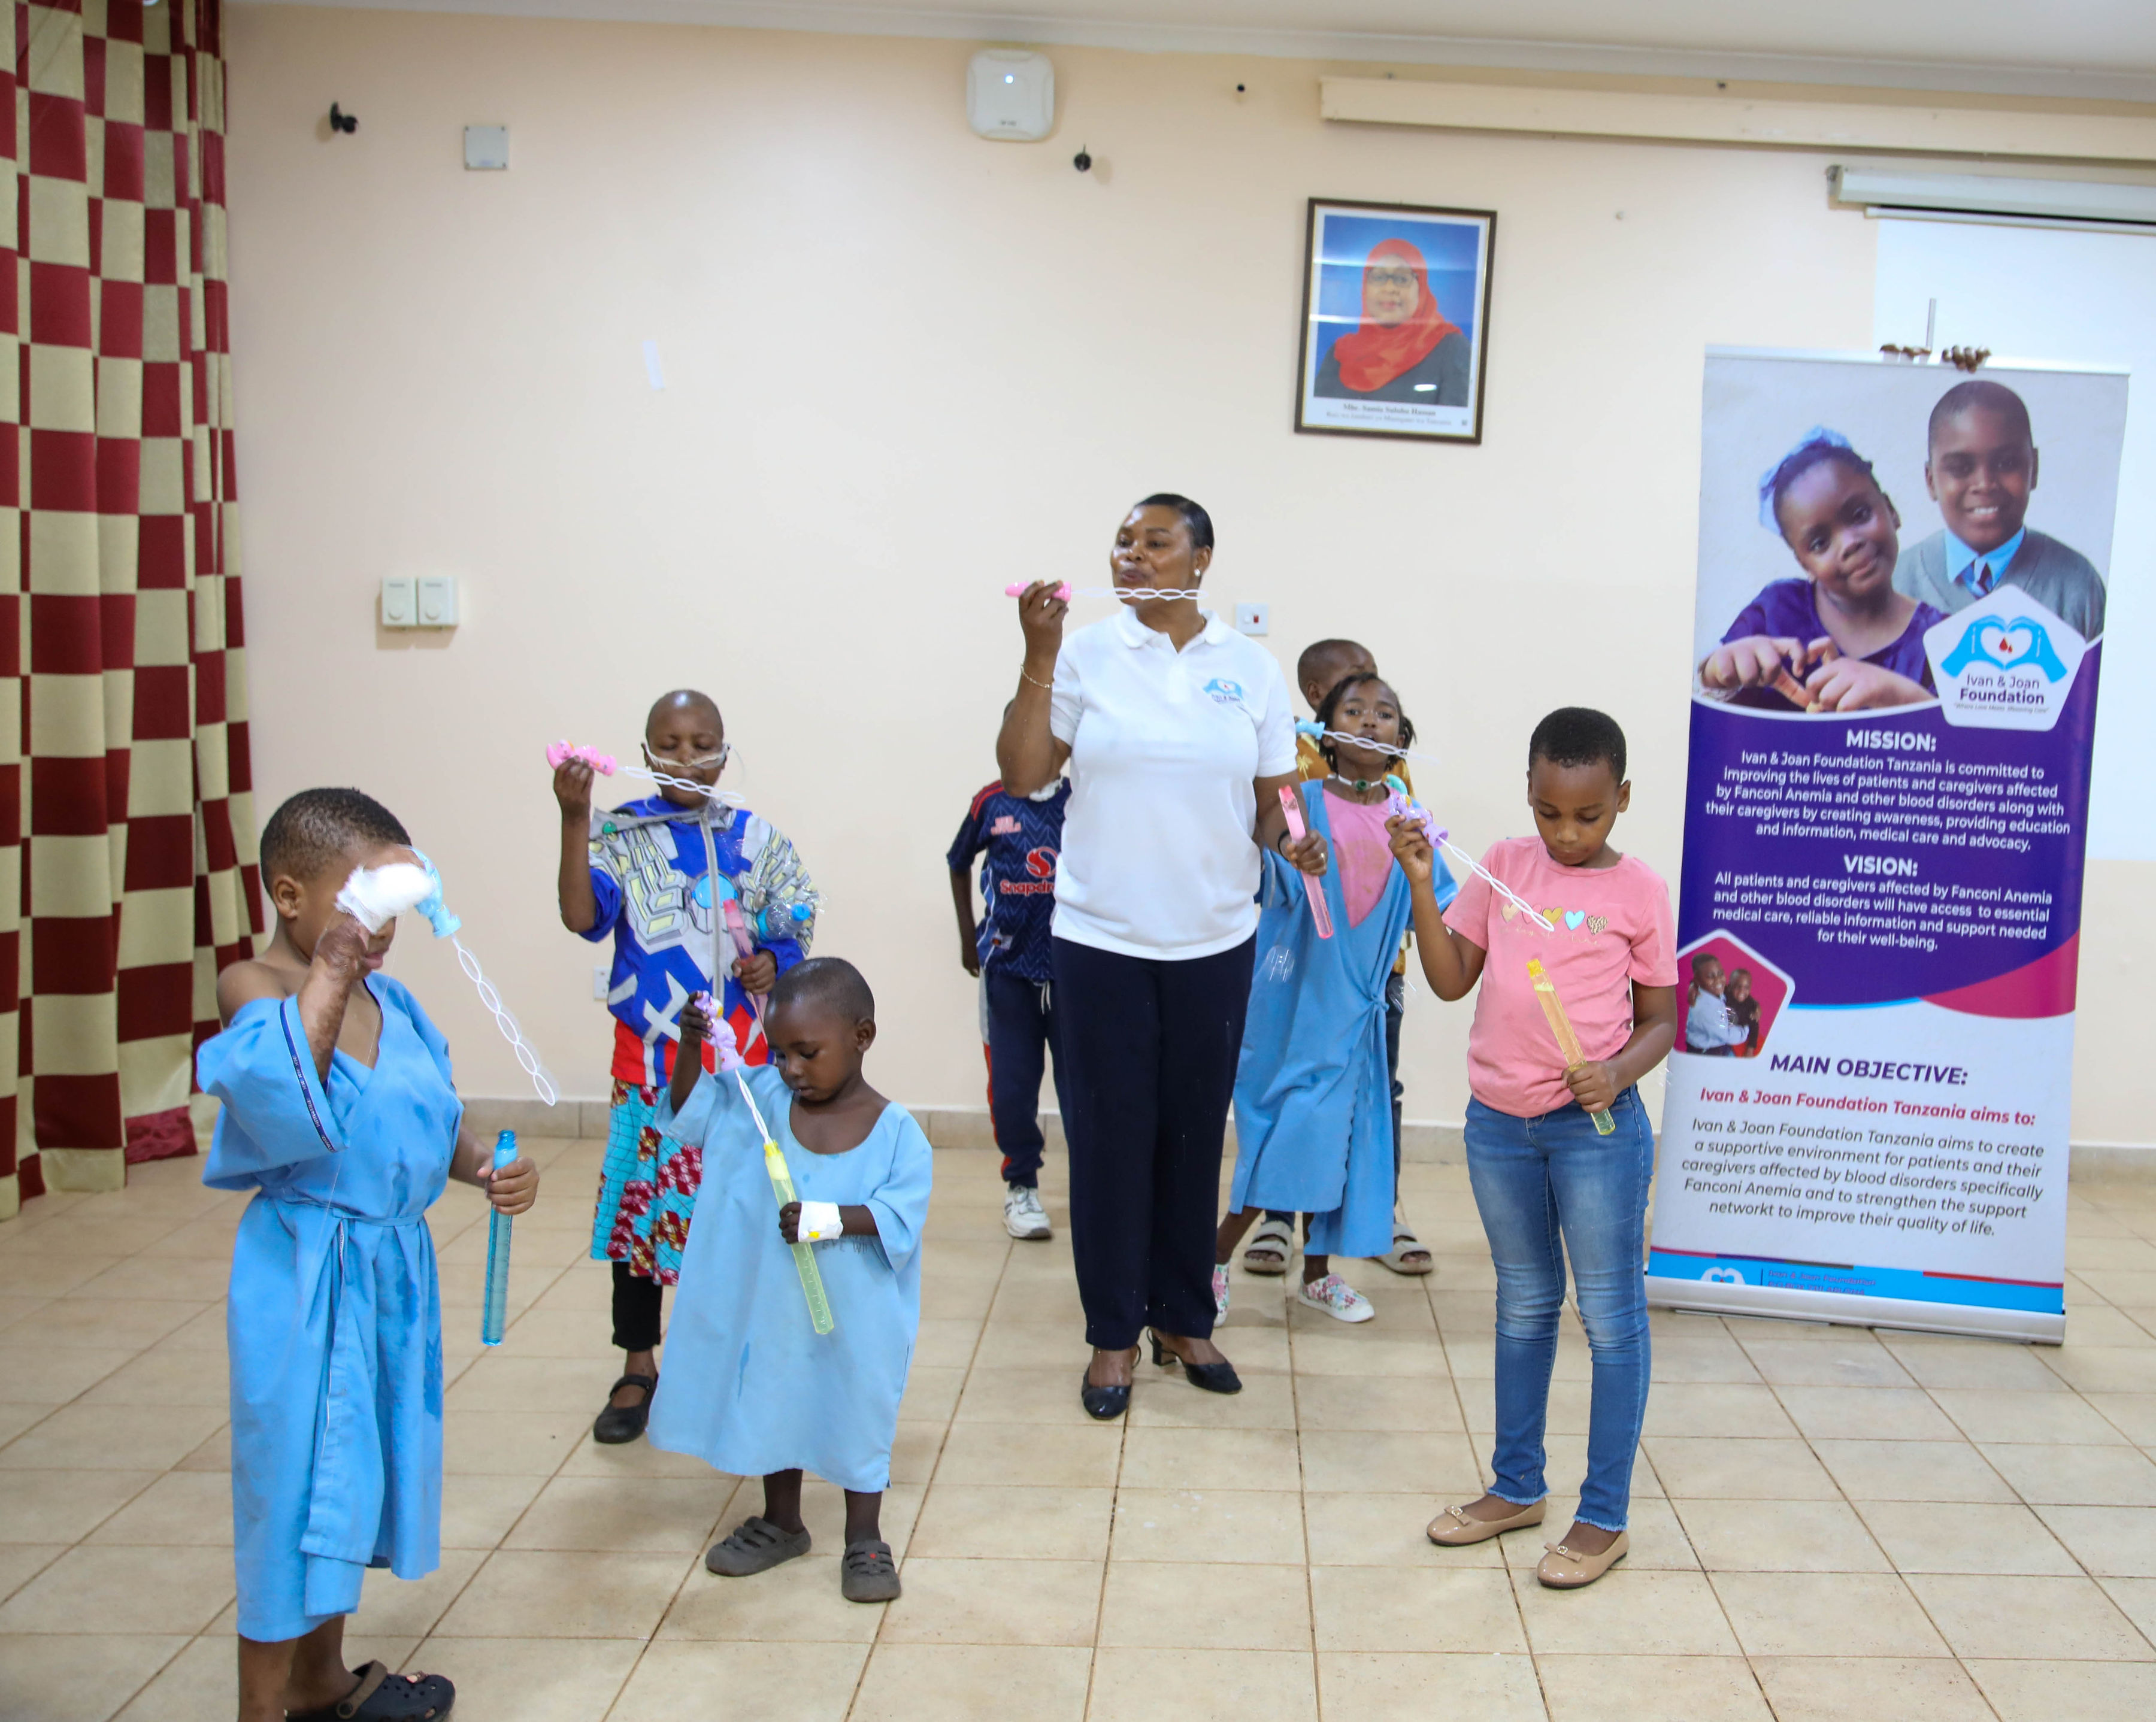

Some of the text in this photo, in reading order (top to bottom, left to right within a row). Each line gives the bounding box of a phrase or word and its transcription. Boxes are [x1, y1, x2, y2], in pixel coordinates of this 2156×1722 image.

[1960, 688, 2044, 704] Foundation
[1967, 674, 2040, 689] Ivan & Joan
[1846, 729, 1937, 752] MISSION:
[1742, 750, 2045, 780] Ivan & Joan Foundation Tanzania is committed to
[1724, 766, 2058, 798] improving the lives of patients and caregivers affected
[1716, 783, 2064, 817] by Fanconi Anemia and other blood disorders along with
[1706, 801, 2070, 834] their caregivers by creating awareness, providing education
[1756, 821, 2031, 853] and information, medical care and advocacy.
[1843, 854, 1918, 877] VISION:
[1715, 871, 2052, 904] All patients and caregivers affected by Fanconi Anemia
[1714, 889, 2049, 922] and other blood disorders will have access to essential
[1713, 907, 2047, 939] medical care, reliable information and support needed
[1818, 928, 1938, 952] for their well-being.
[1770, 1054, 1968, 1085] MAIN OBJECTIVE:
[1700, 1087, 2036, 1126] Ivan & Joan Foundation Tanzania aims to:
[1692, 1118, 2044, 1157] Ivan & Joan Foundation Tanzania aims to create
[1694, 1141, 2042, 1178] a supportive environment for patients and their
[1682, 1160, 2043, 1202] caregivers affected by blood disorders specifically
[1684, 1178, 2026, 1218] Fanconi Anemia and to strengthen the support
[1709, 1202, 1994, 1236] networkt to improve their quality of life.
